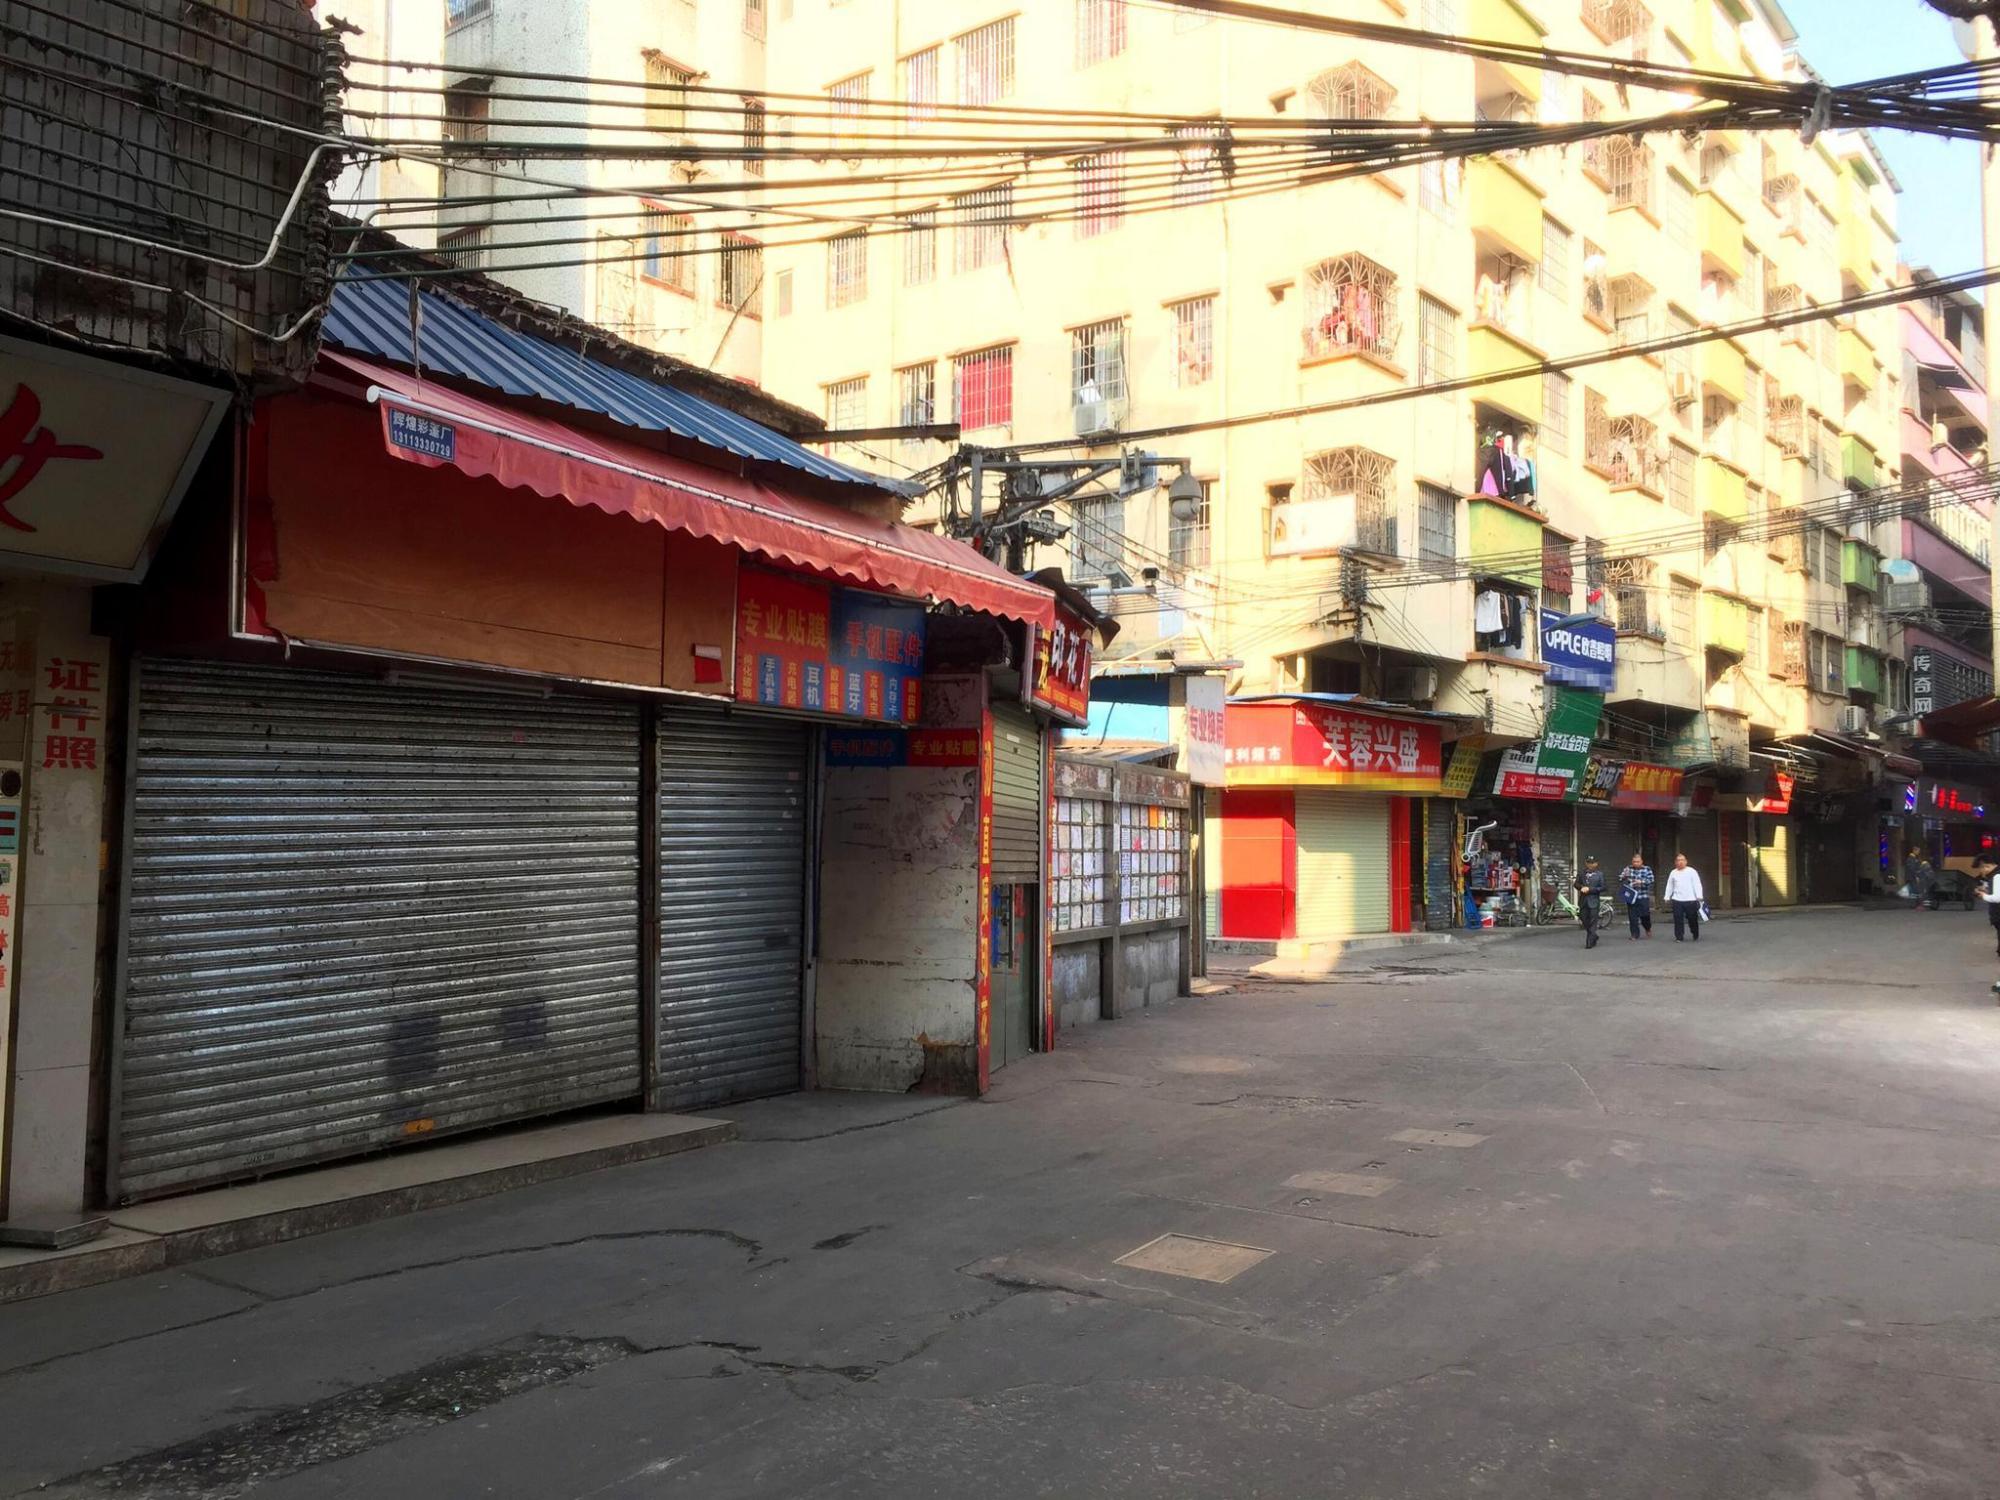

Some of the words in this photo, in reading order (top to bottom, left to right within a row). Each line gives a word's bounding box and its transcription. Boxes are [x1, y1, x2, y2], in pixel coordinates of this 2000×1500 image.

[742, 598, 827, 649] 专业贴膜
[846, 620, 922, 668] 手机配件
[806, 665, 821, 706] 耳机
[847, 672, 862, 711] 蓝牙
[43, 657, 101, 771] 证件照
[911, 738, 977, 757] 专业贴膜
[1322, 714, 1421, 774] 芙蓉兴盛
